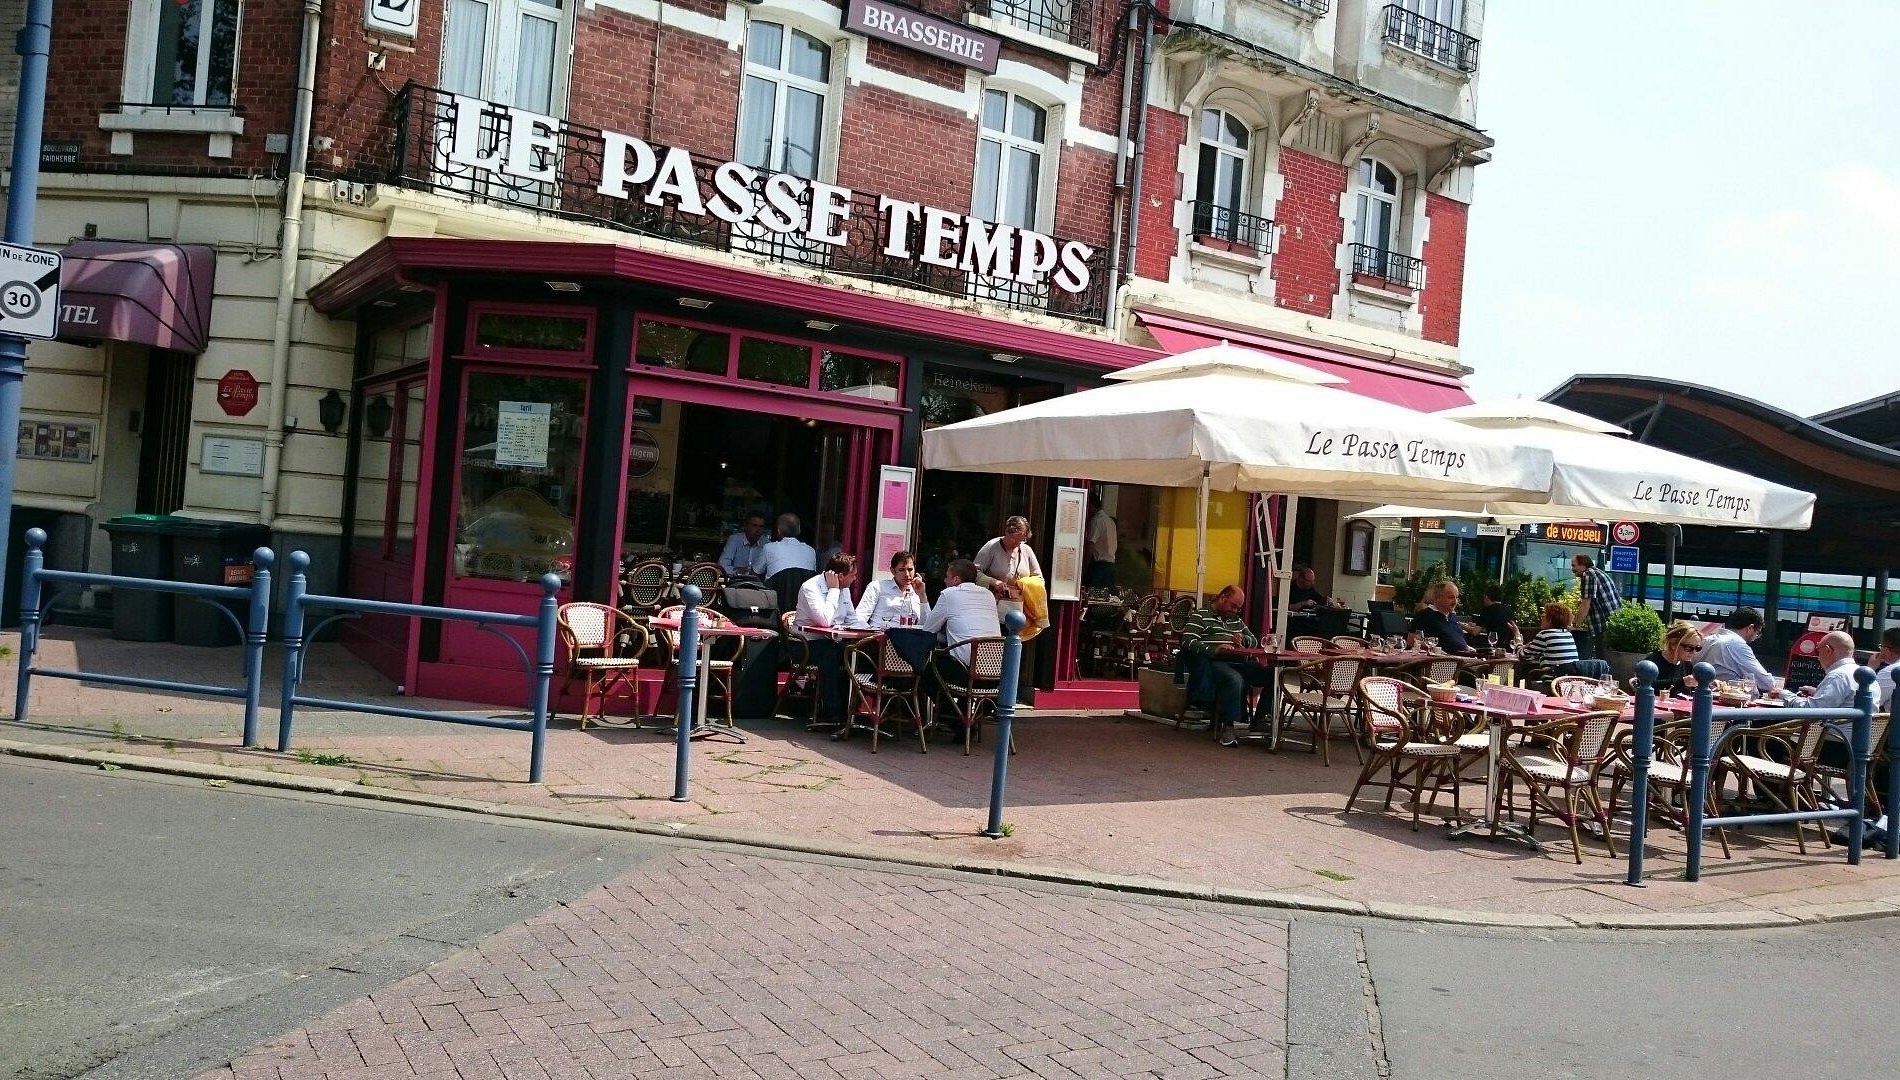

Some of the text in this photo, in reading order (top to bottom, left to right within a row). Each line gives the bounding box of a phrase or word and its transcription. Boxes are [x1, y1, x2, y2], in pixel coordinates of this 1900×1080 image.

[863, 5, 985, 62] BRASSERIE
[42, 154, 76, 163] FAIDHERBE
[448, 94, 1094, 294] LE PASSE TEMPS
[25, 253, 55, 267] ZONE
[7, 291, 31, 308] 30
[933, 373, 993, 393] Heineken
[1305, 431, 1466, 477] Le Passe Temps
[1633, 480, 1751, 519] Le Passe Temps
[1546, 522, 1602, 543] de voyageu
